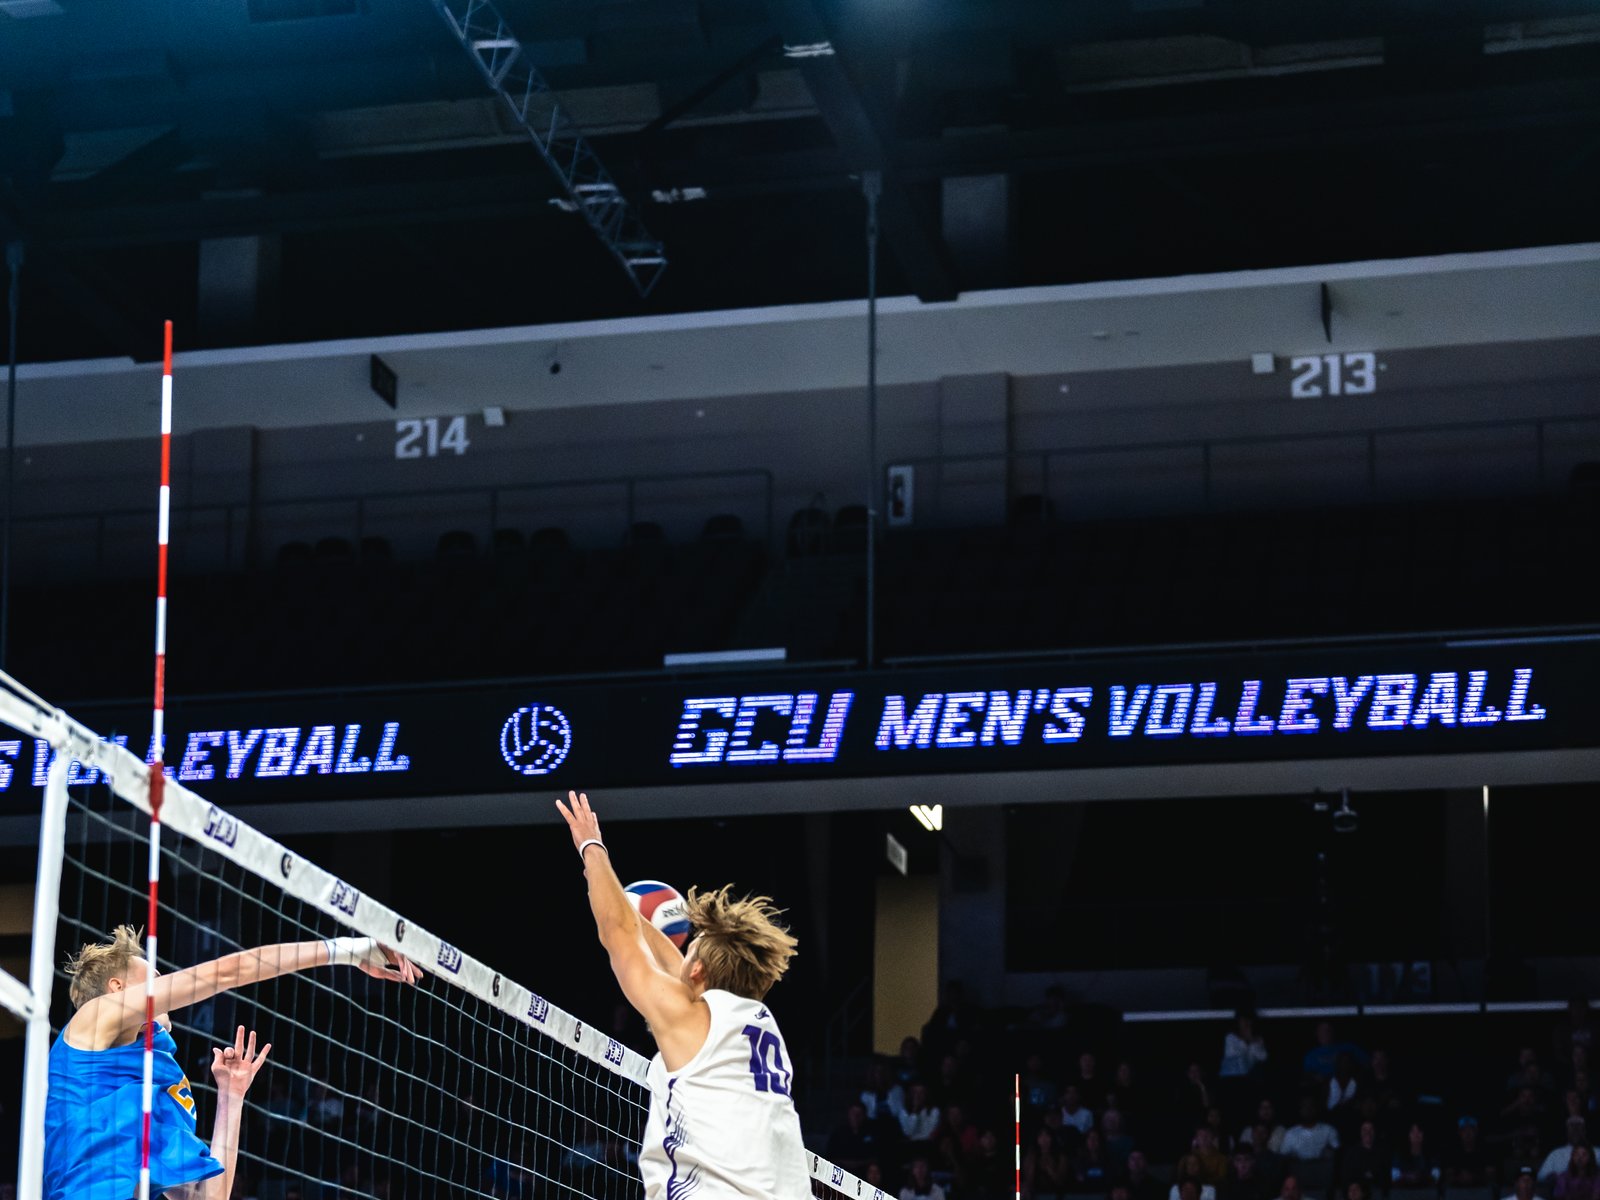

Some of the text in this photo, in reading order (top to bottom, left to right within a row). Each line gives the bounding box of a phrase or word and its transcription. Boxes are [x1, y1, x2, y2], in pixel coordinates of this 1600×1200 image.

[1291, 352, 1376, 398] 213
[395, 416, 470, 458] 214
[669, 667, 1547, 767] GCU MEN'S VOLLEYBALL
[741, 1024, 791, 1098] 10
